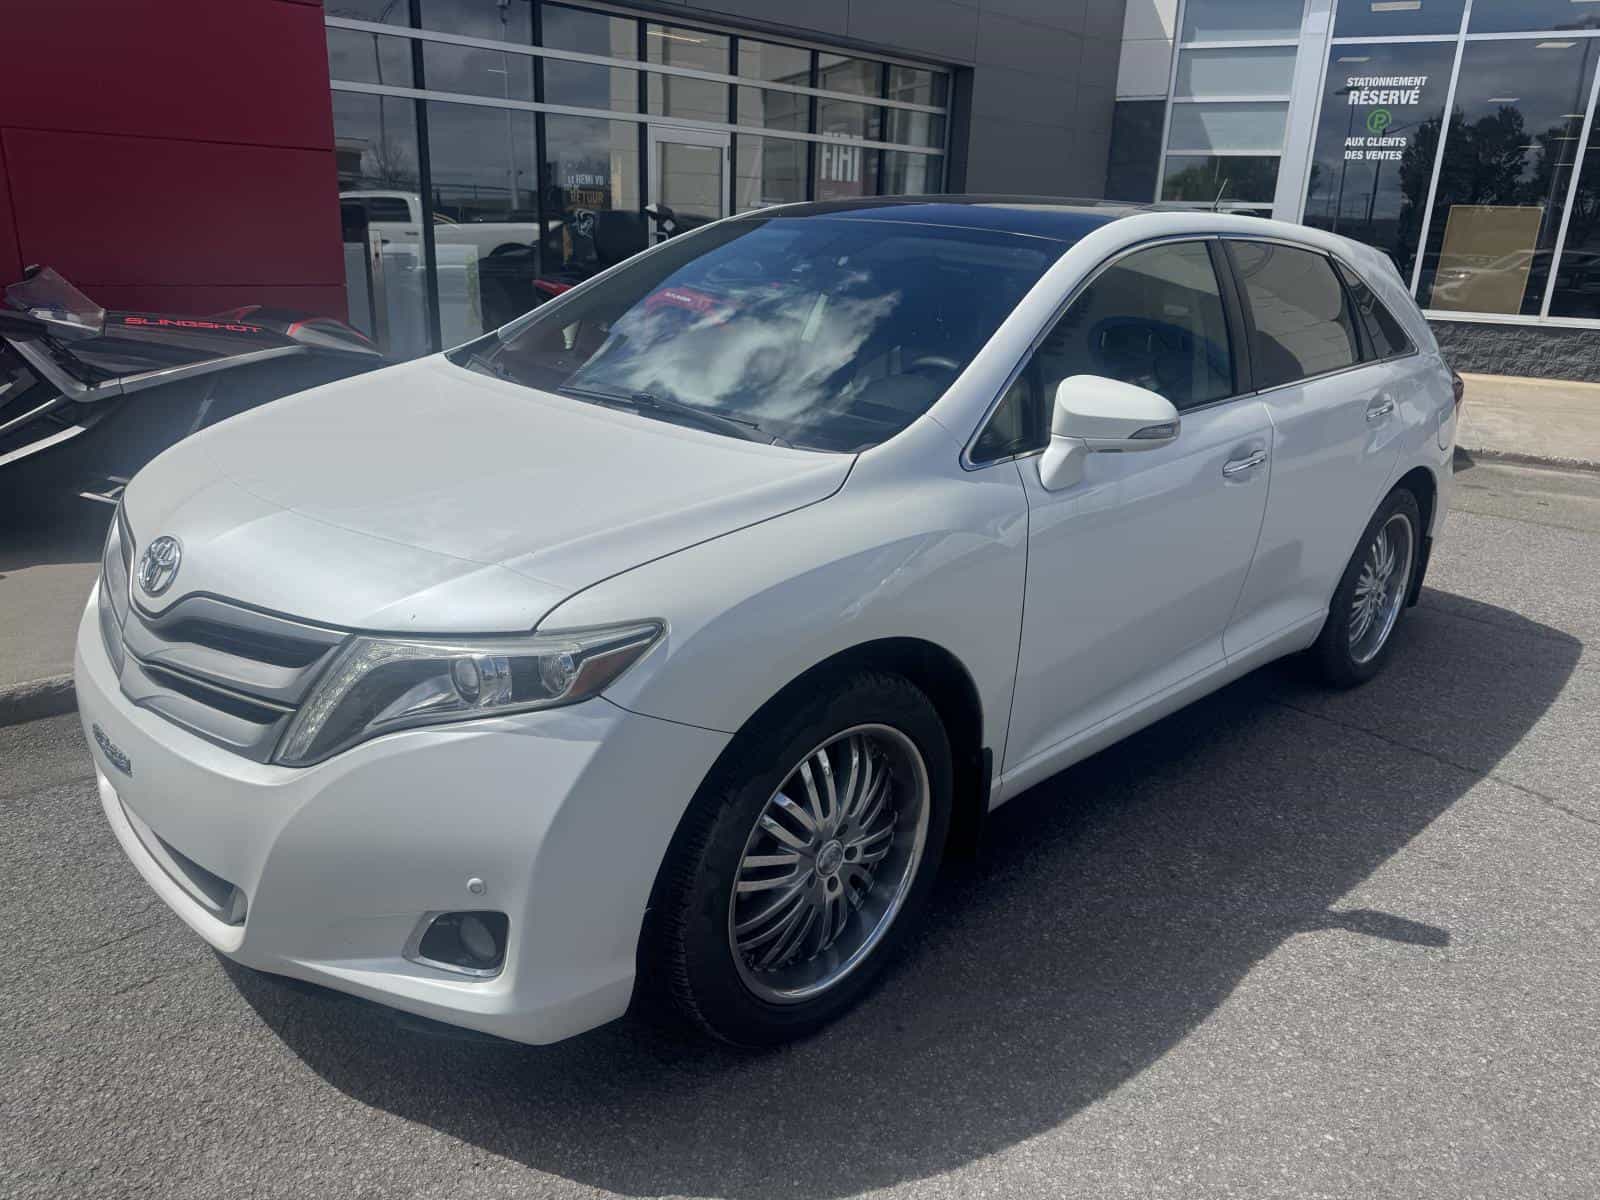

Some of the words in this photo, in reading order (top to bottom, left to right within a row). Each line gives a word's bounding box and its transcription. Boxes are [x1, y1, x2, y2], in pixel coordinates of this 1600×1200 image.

[1346, 76, 1428, 87] STATIONNEMENT
[1348, 86, 1421, 105] RÉSERVÉ
[1344, 137, 1365, 146] AUX
[1366, 137, 1407, 146] CLIENTS
[1344, 150, 1363, 160] DES
[1365, 150, 1403, 160] VENTES
[124, 317, 264, 333] SLINGSHOT
